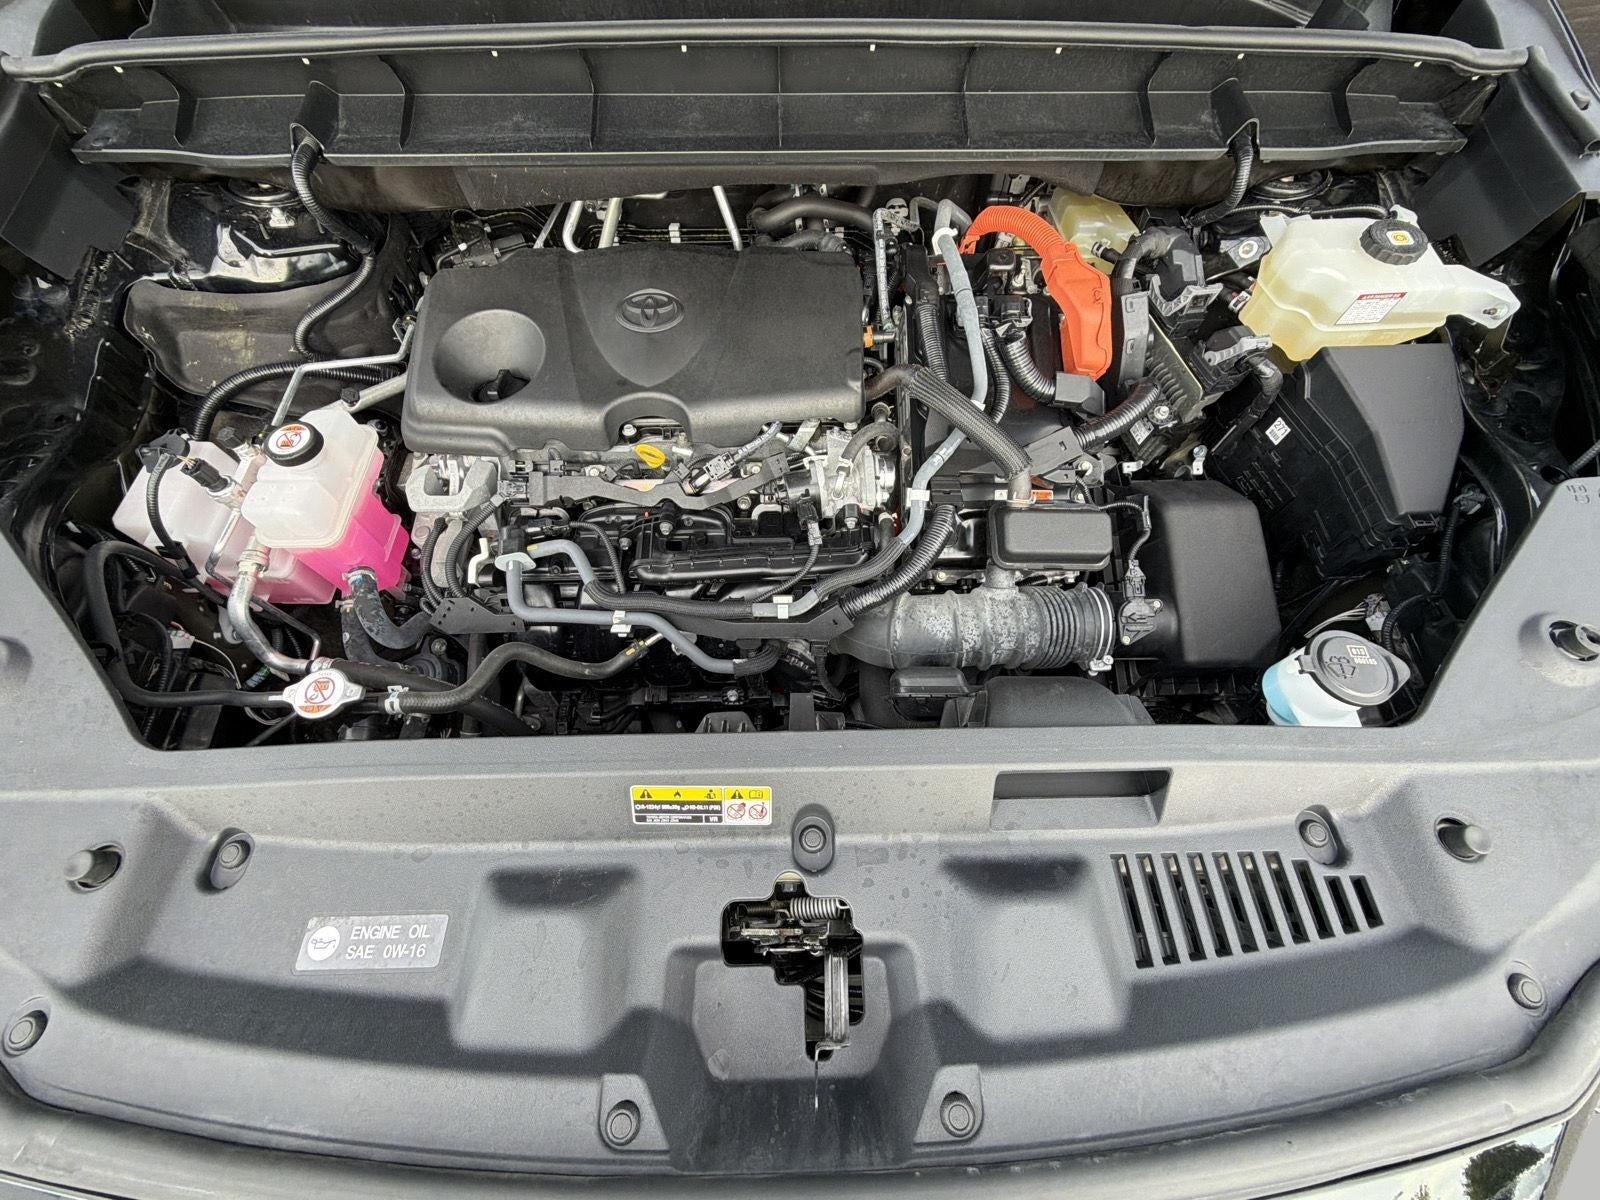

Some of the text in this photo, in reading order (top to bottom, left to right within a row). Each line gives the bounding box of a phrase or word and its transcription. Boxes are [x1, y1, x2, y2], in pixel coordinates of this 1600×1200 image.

[1274, 420, 1287, 436] 271
[350, 924, 431, 940] ENGINE OIL
[345, 943, 426, 960] SAE 0W-16
